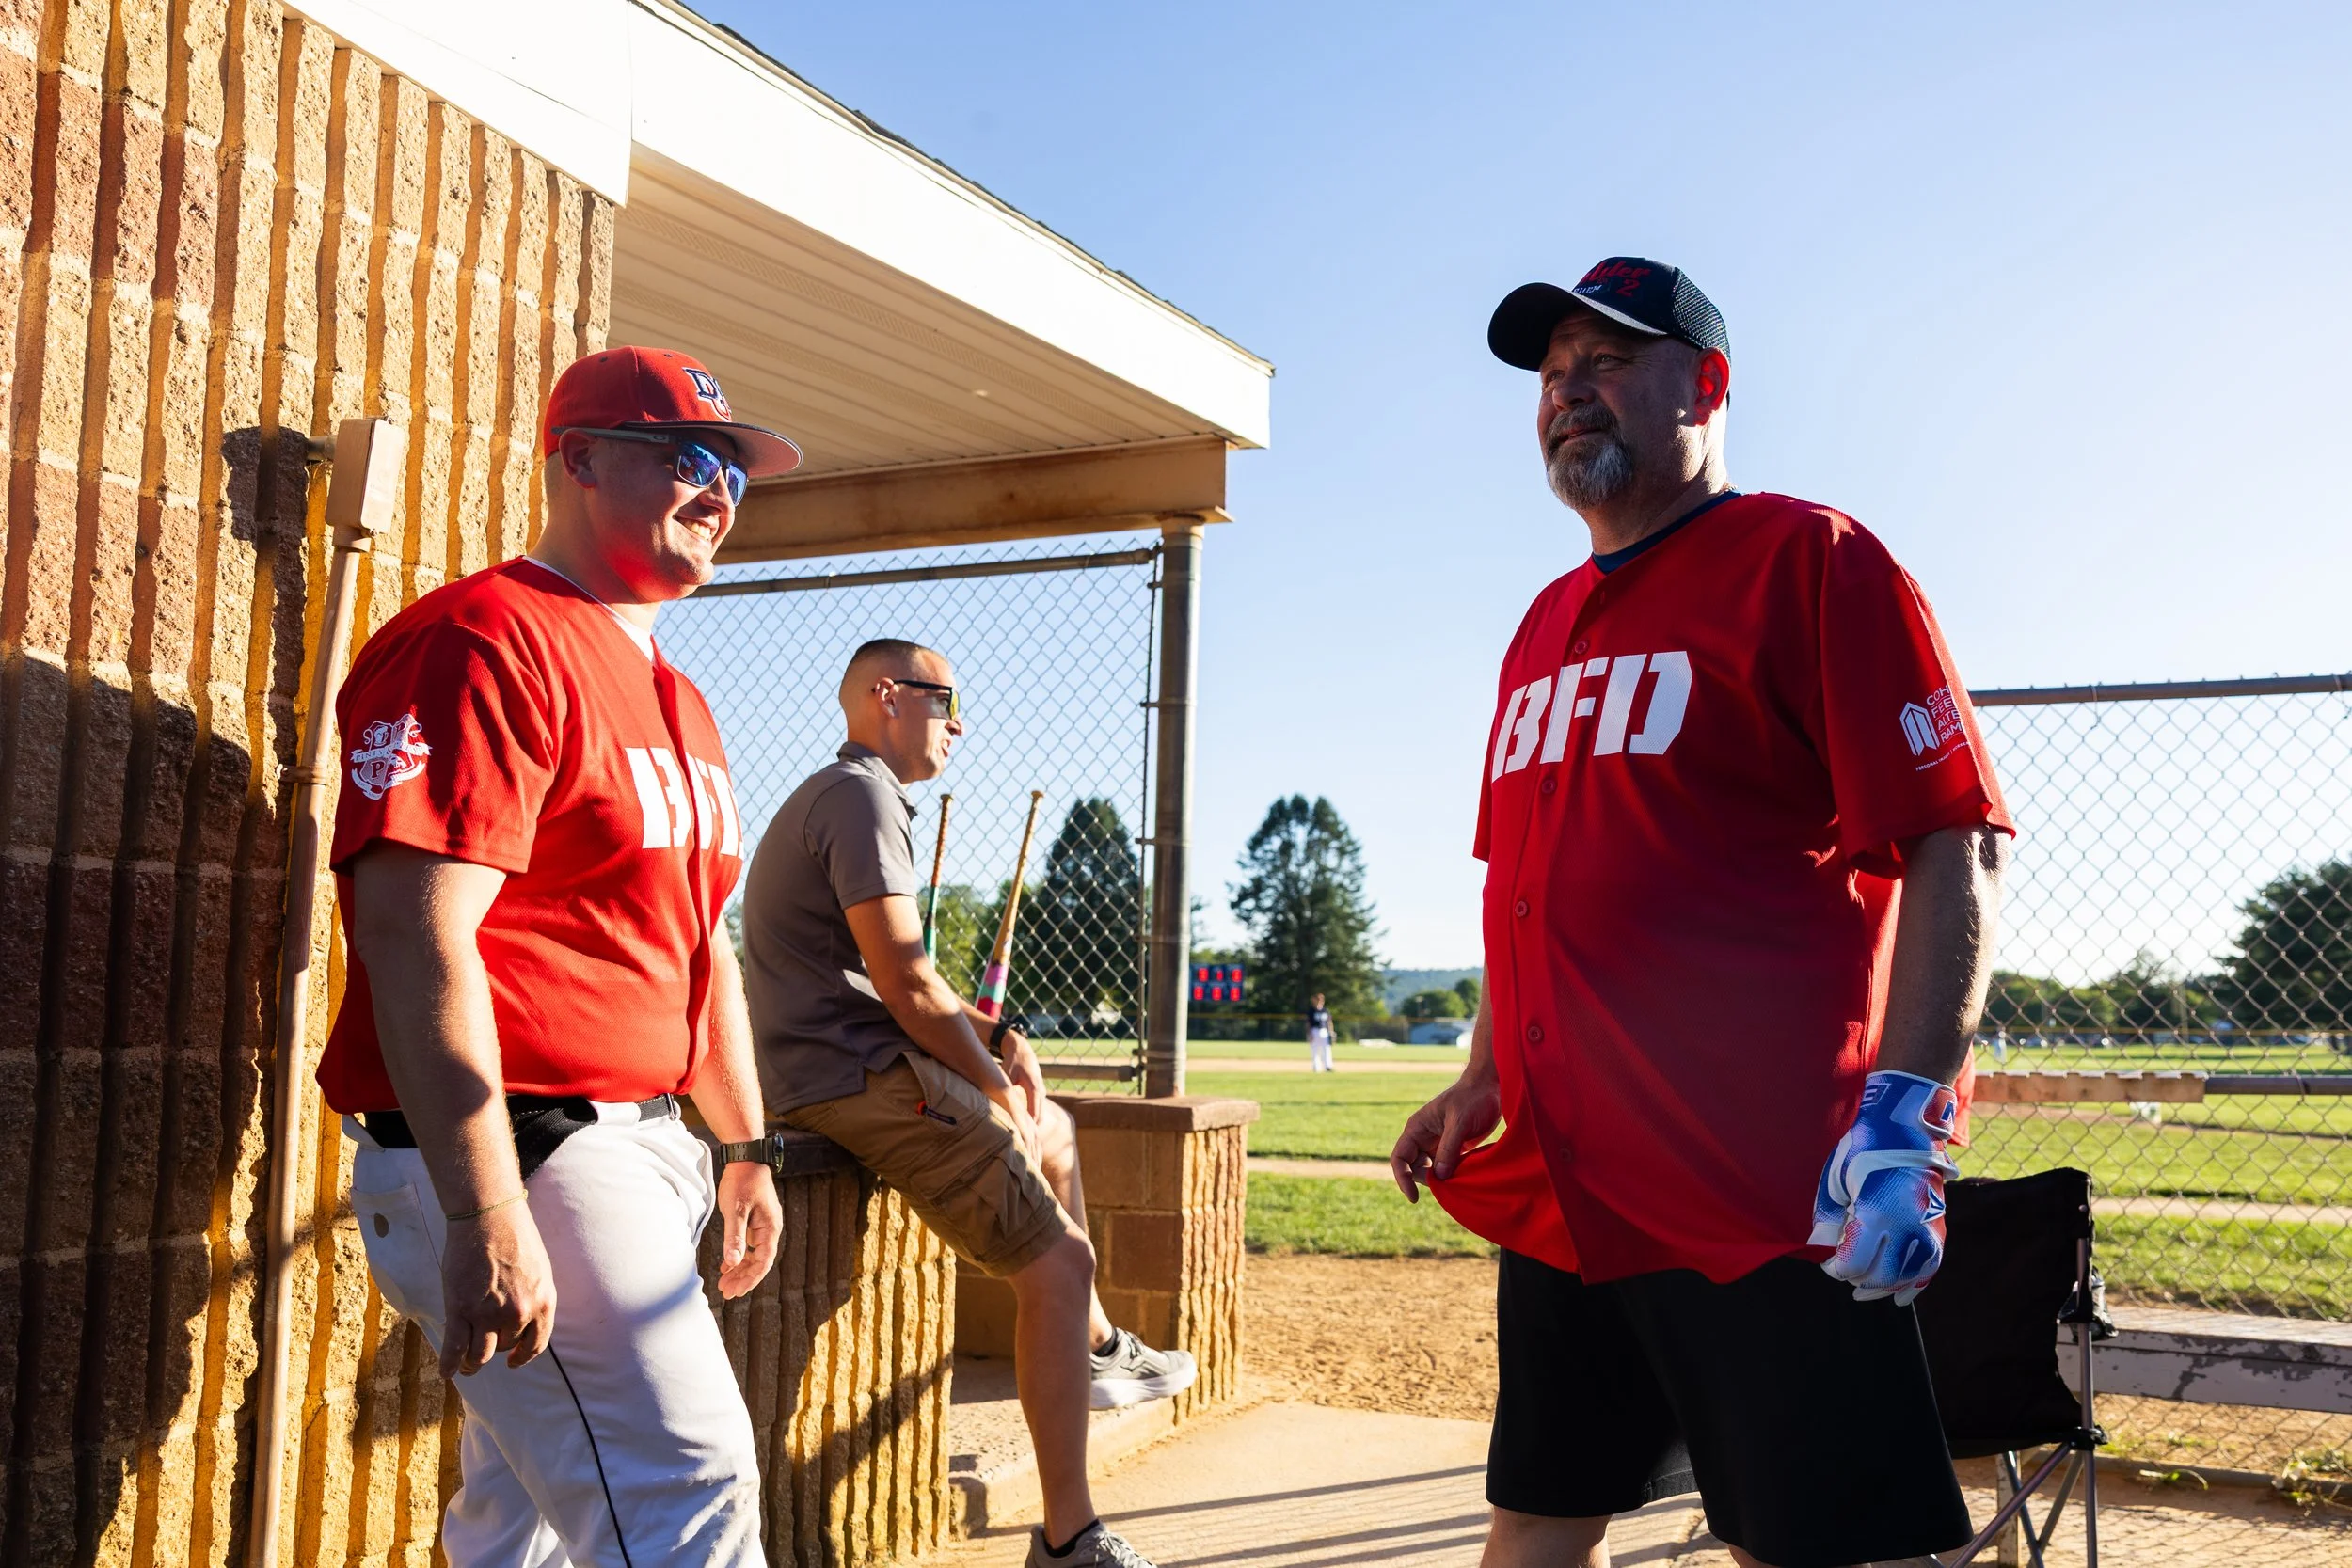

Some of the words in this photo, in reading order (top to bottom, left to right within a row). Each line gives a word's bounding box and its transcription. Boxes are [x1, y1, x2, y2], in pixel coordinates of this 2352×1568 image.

[1614, 278, 1641, 297] 2
[1926, 685, 1950, 706] COH
[1491, 651, 1692, 783] BFD
[1931, 697, 1955, 719] FEE
[1937, 710, 1961, 731] ALTE
[1940, 722, 1963, 743] RAM
[371, 760, 386, 780] P
